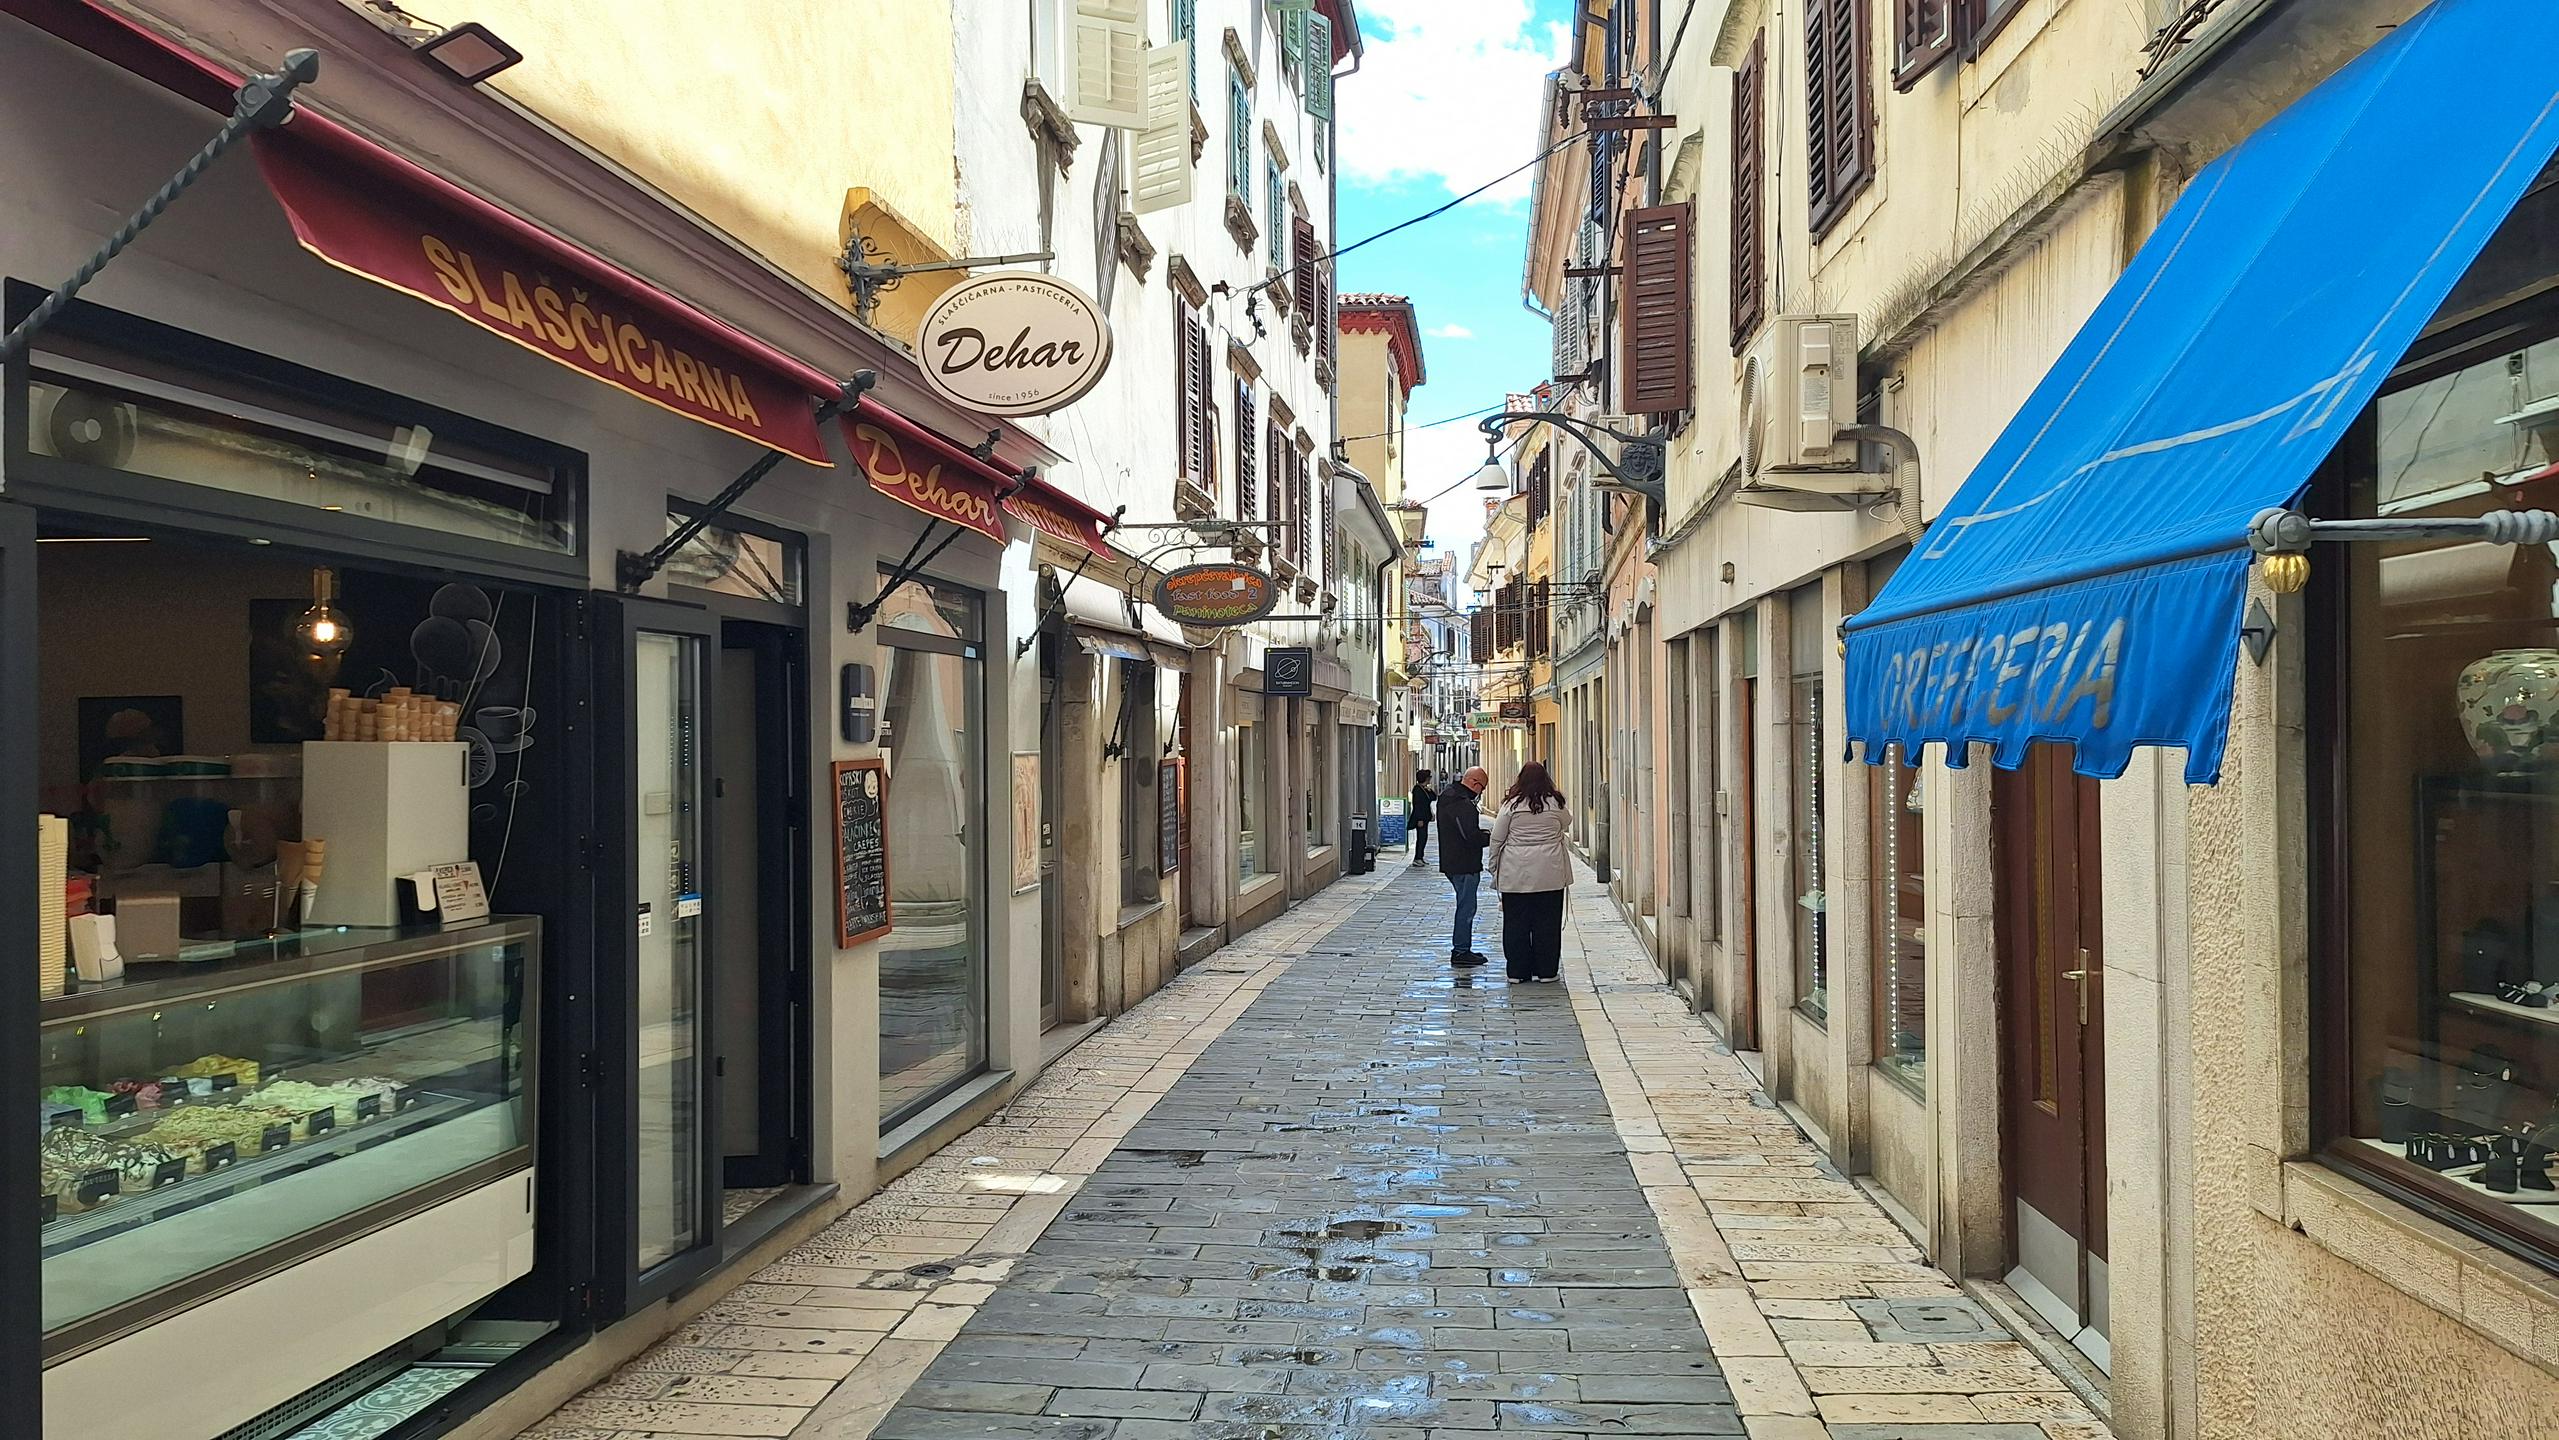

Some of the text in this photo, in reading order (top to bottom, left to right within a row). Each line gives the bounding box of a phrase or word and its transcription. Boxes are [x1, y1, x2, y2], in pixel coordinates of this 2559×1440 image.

[938, 285, 1005, 326] SLAŠČIČARNA
[1016, 284, 1080, 315] PASTICCERIA
[937, 326, 1085, 375] Dehar
[988, 388, 1040, 401] since 1956
[856, 423, 995, 527] Dehar
[1206, 587, 1240, 600] food
[1247, 587, 1258, 600] 2
[1394, 691, 1405, 735] VALA
